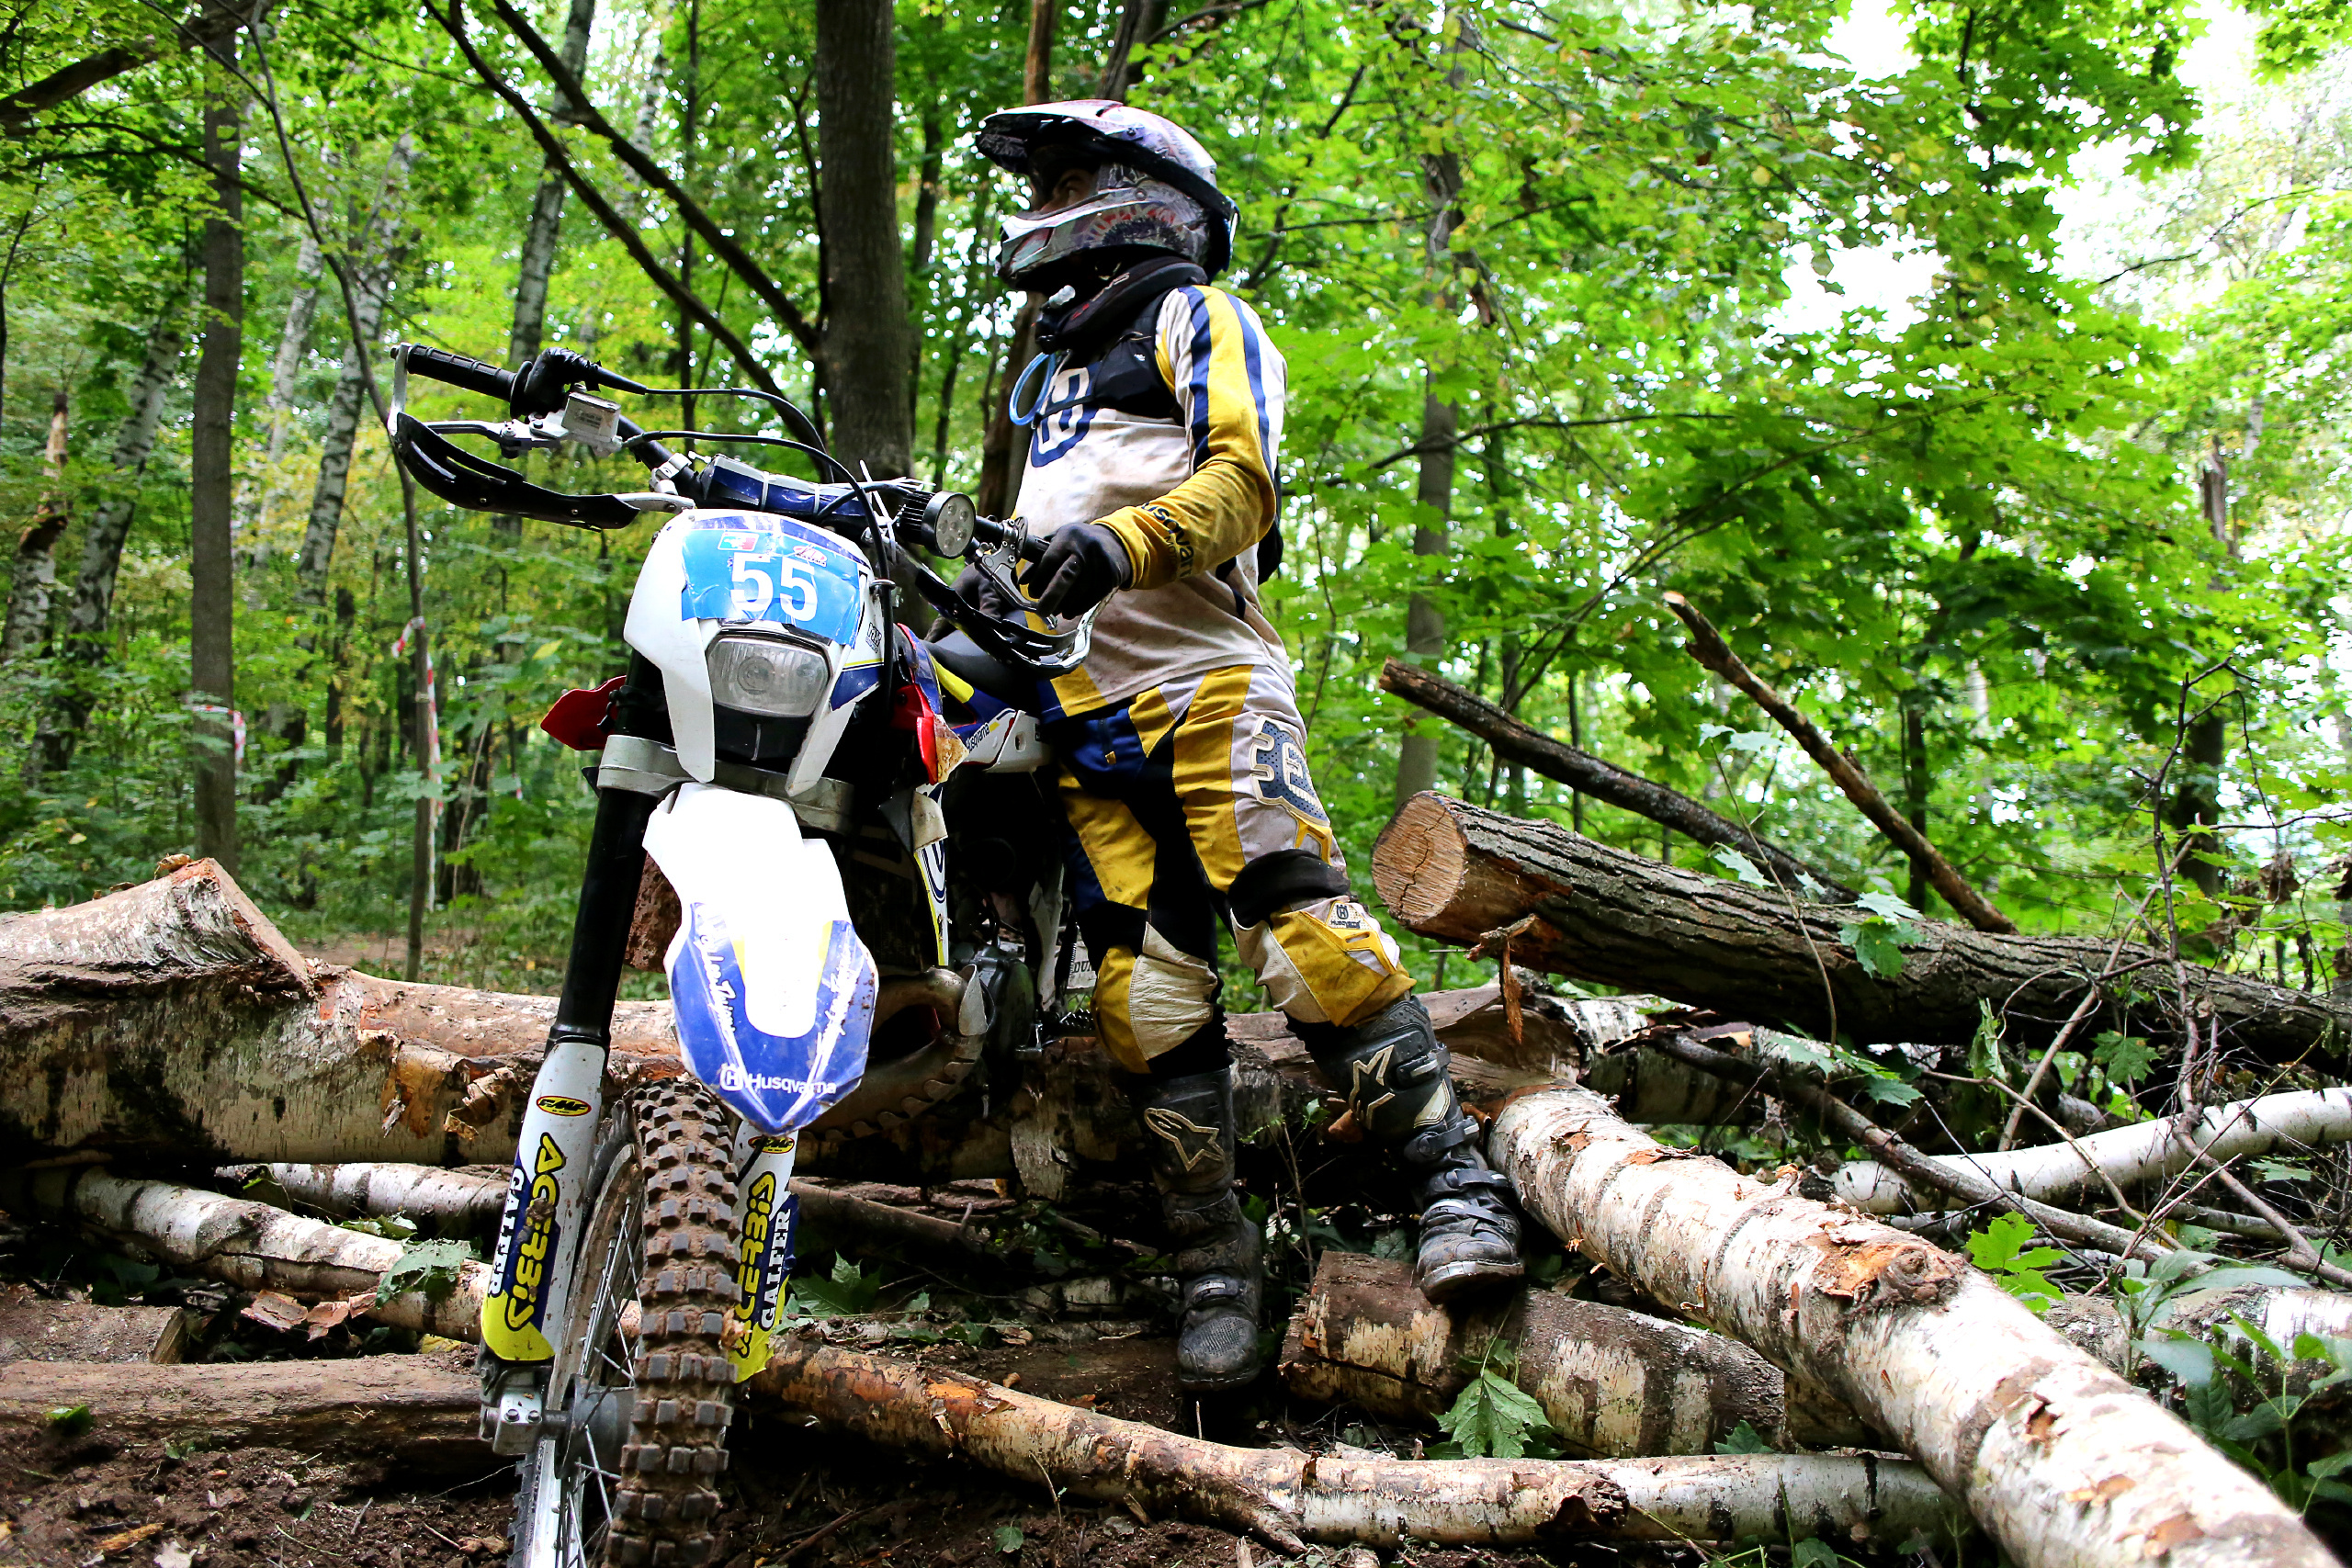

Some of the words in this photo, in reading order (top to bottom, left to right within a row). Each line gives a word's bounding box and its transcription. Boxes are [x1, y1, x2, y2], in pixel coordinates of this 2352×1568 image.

[730, 552, 818, 622] 55
[746, 1073, 837, 1094] Husqvarna
[761, 1209, 790, 1329] GALFER
